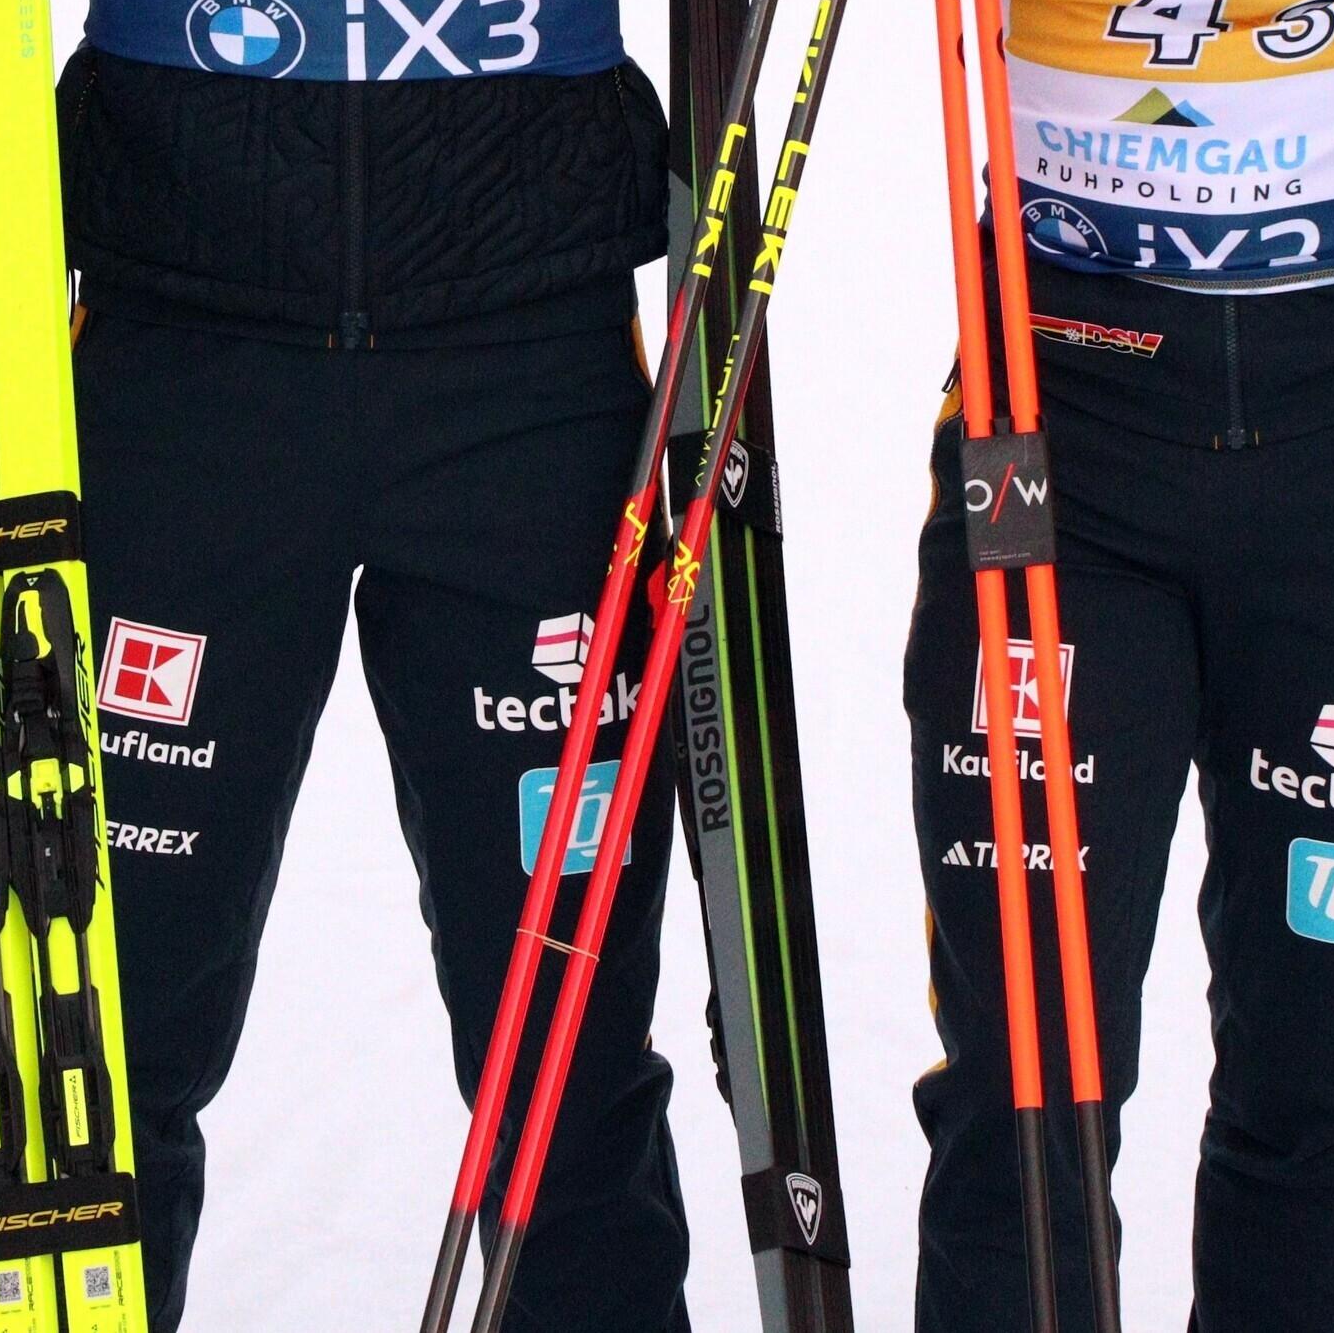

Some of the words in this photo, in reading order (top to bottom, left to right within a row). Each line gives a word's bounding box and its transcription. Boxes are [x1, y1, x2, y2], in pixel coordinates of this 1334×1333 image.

[1035, 120, 1308, 175] CHIEMGAU
[692, 123, 747, 278] LEKI
[1037, 157, 1303, 204] RUHPOLDING
[748, 140, 810, 295] LEKI
[1026, 204, 1094, 236] BMW
[1080, 321, 1164, 358] DSV
[474, 668, 641, 732] tectak
[681, 604, 731, 833] ROSSIGNOL
[100, 729, 216, 770] ufland
[942, 744, 1095, 784] Kaulad
[104, 819, 200, 857] ERREX
[74, 1083, 84, 1140] FISCHER
